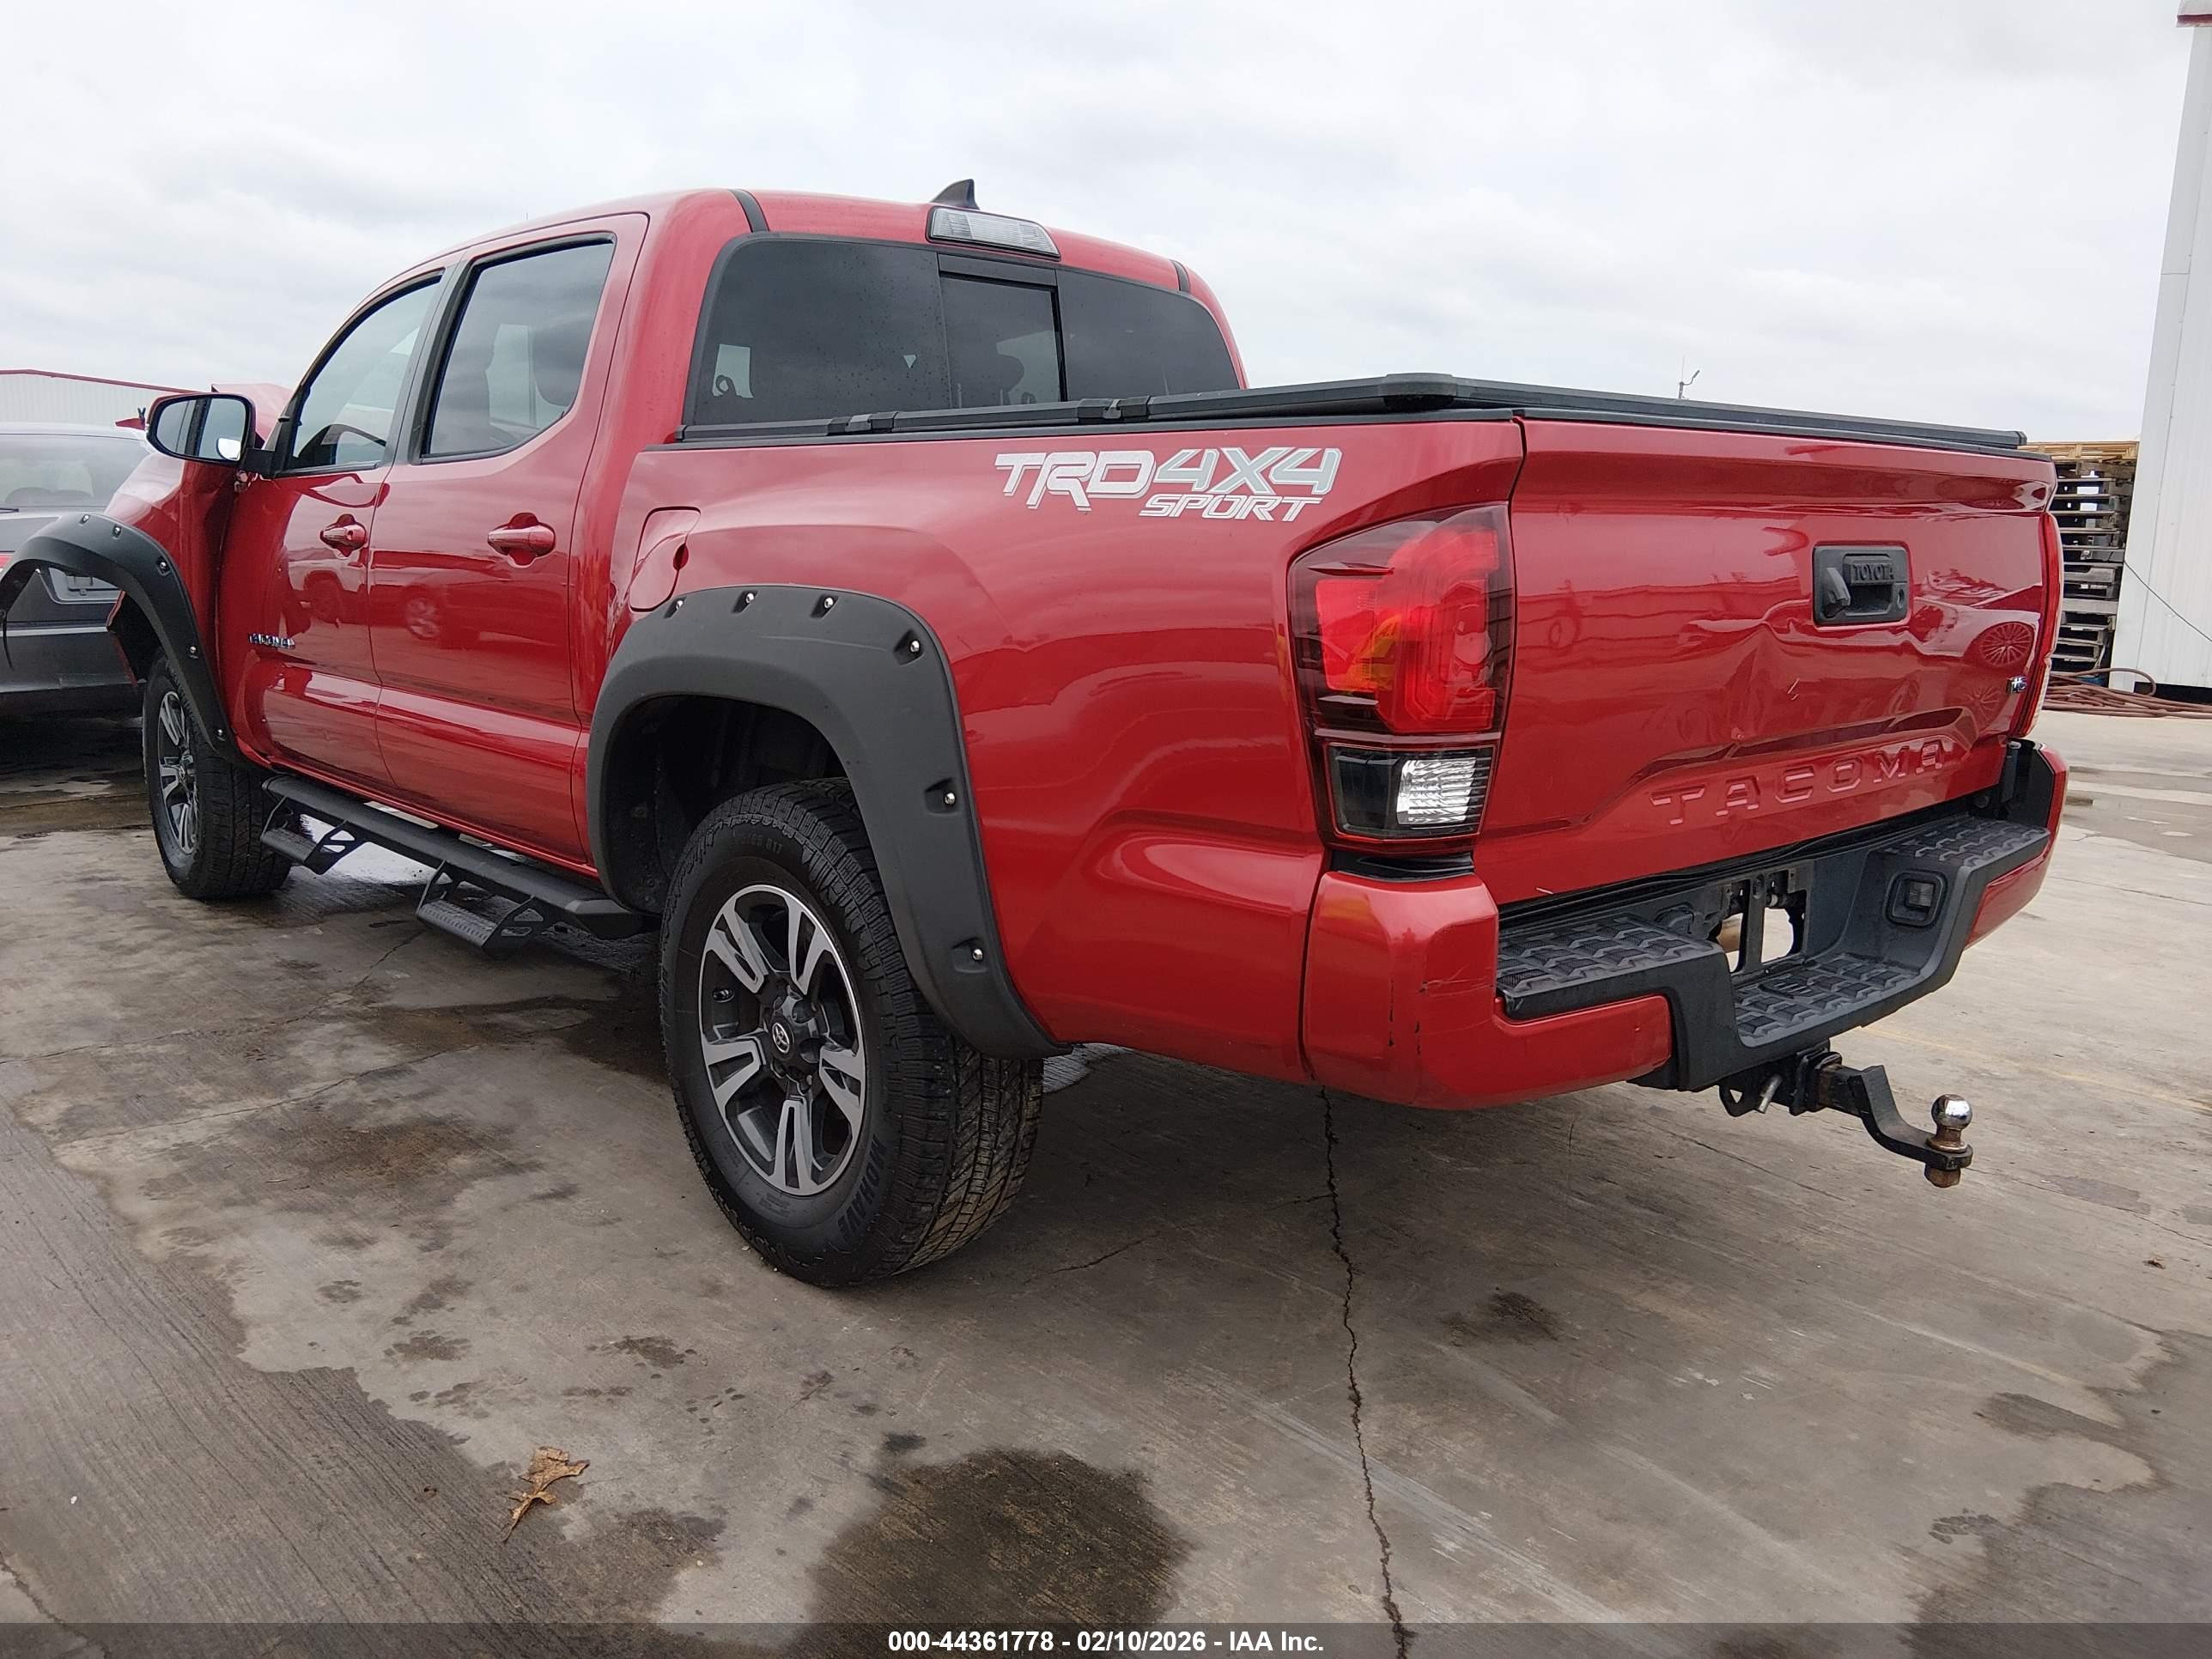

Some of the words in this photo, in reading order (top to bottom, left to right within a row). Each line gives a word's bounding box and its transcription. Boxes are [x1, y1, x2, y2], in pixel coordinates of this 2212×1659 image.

[1139, 493, 1323, 522] SPORT
[1852, 563, 1894, 580] TOYOTA
[1649, 738, 1944, 825] TACOMA
